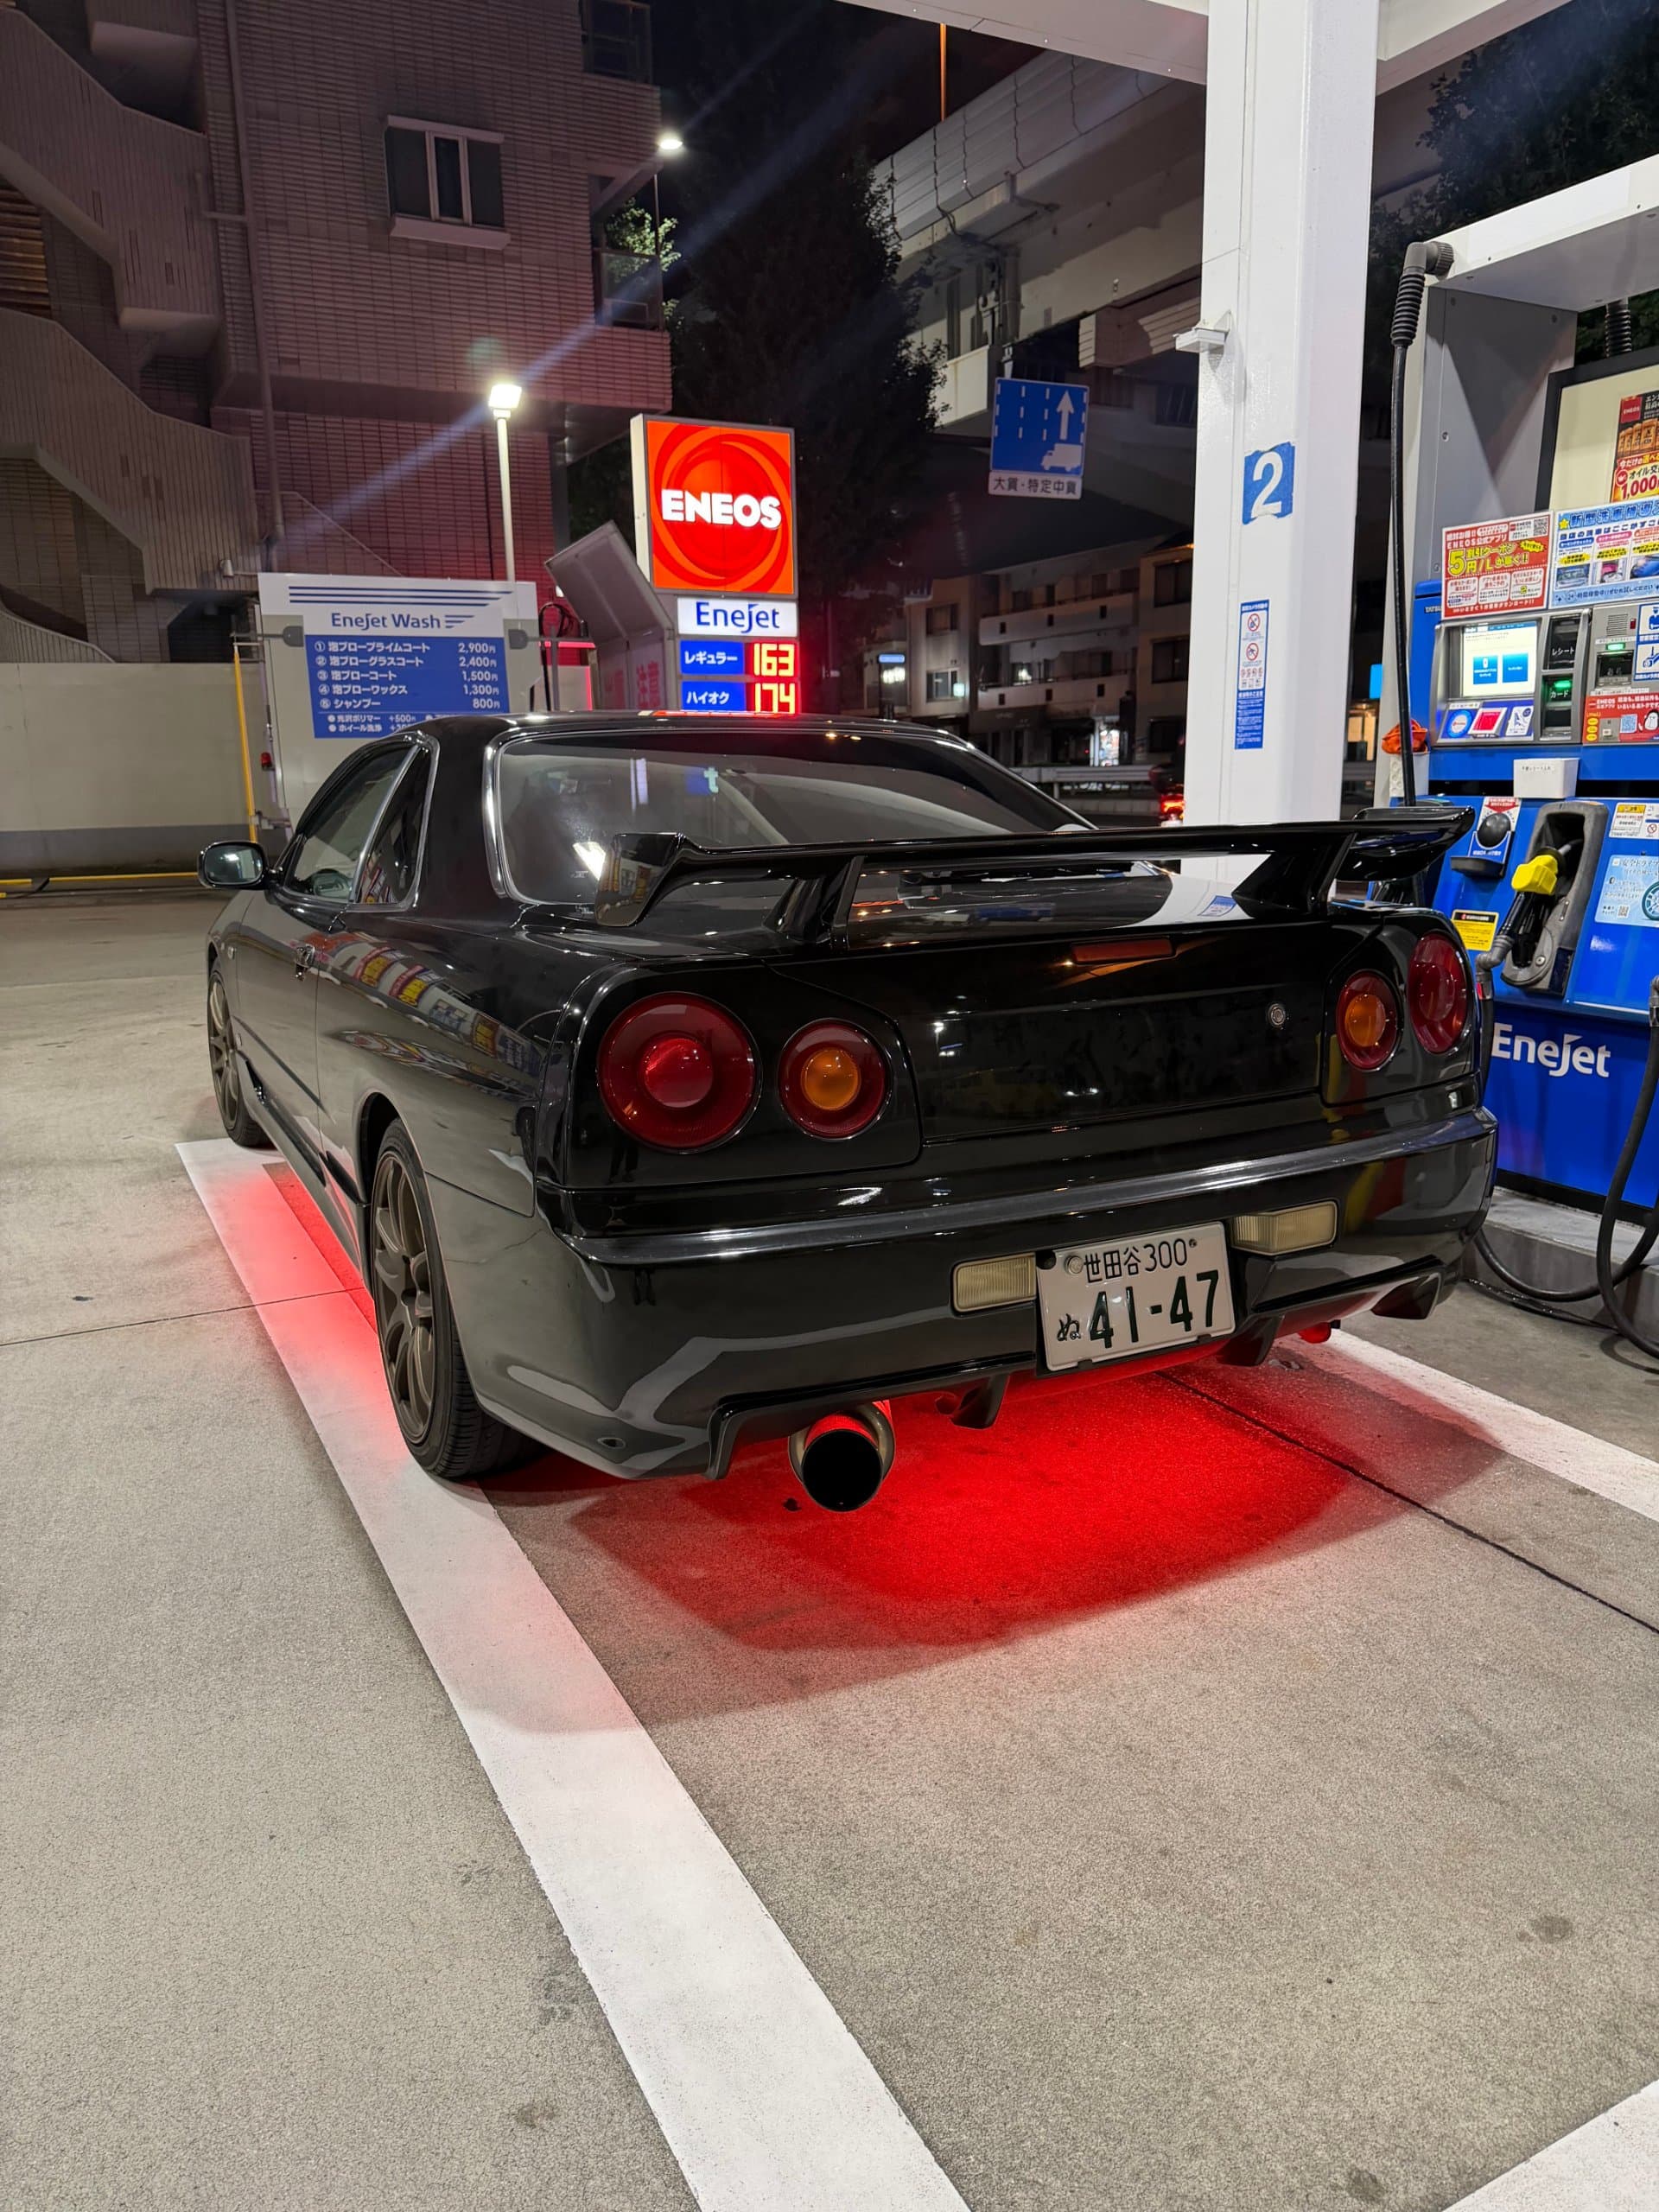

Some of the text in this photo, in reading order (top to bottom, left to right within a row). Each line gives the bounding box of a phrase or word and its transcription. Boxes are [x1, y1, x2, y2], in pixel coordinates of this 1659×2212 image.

[1251, 451, 1283, 518] 2
[1621, 474, 1659, 499] 1,000
[661, 489, 782, 531] ENEOS
[331, 613, 441, 631] Enejet Wash
[696, 601, 779, 633] Enejet
[458, 643, 496, 653] 2,900円
[1552, 646, 1574, 657] レシート
[459, 657, 497, 668] 2,400円
[684, 650, 738, 665] レギュラー
[753, 643, 795, 677] 163
[462, 671, 498, 682] 1,500円
[463, 684, 499, 695] 1,300円
[686, 690, 730, 705] ハイオク
[1550, 690, 1569, 699] カード
[473, 698, 500, 709] 800円
[755, 683, 796, 715] 174
[1491, 1022, 1611, 1077] Enejet
[1089, 1269, 1219, 1349] 41-47
